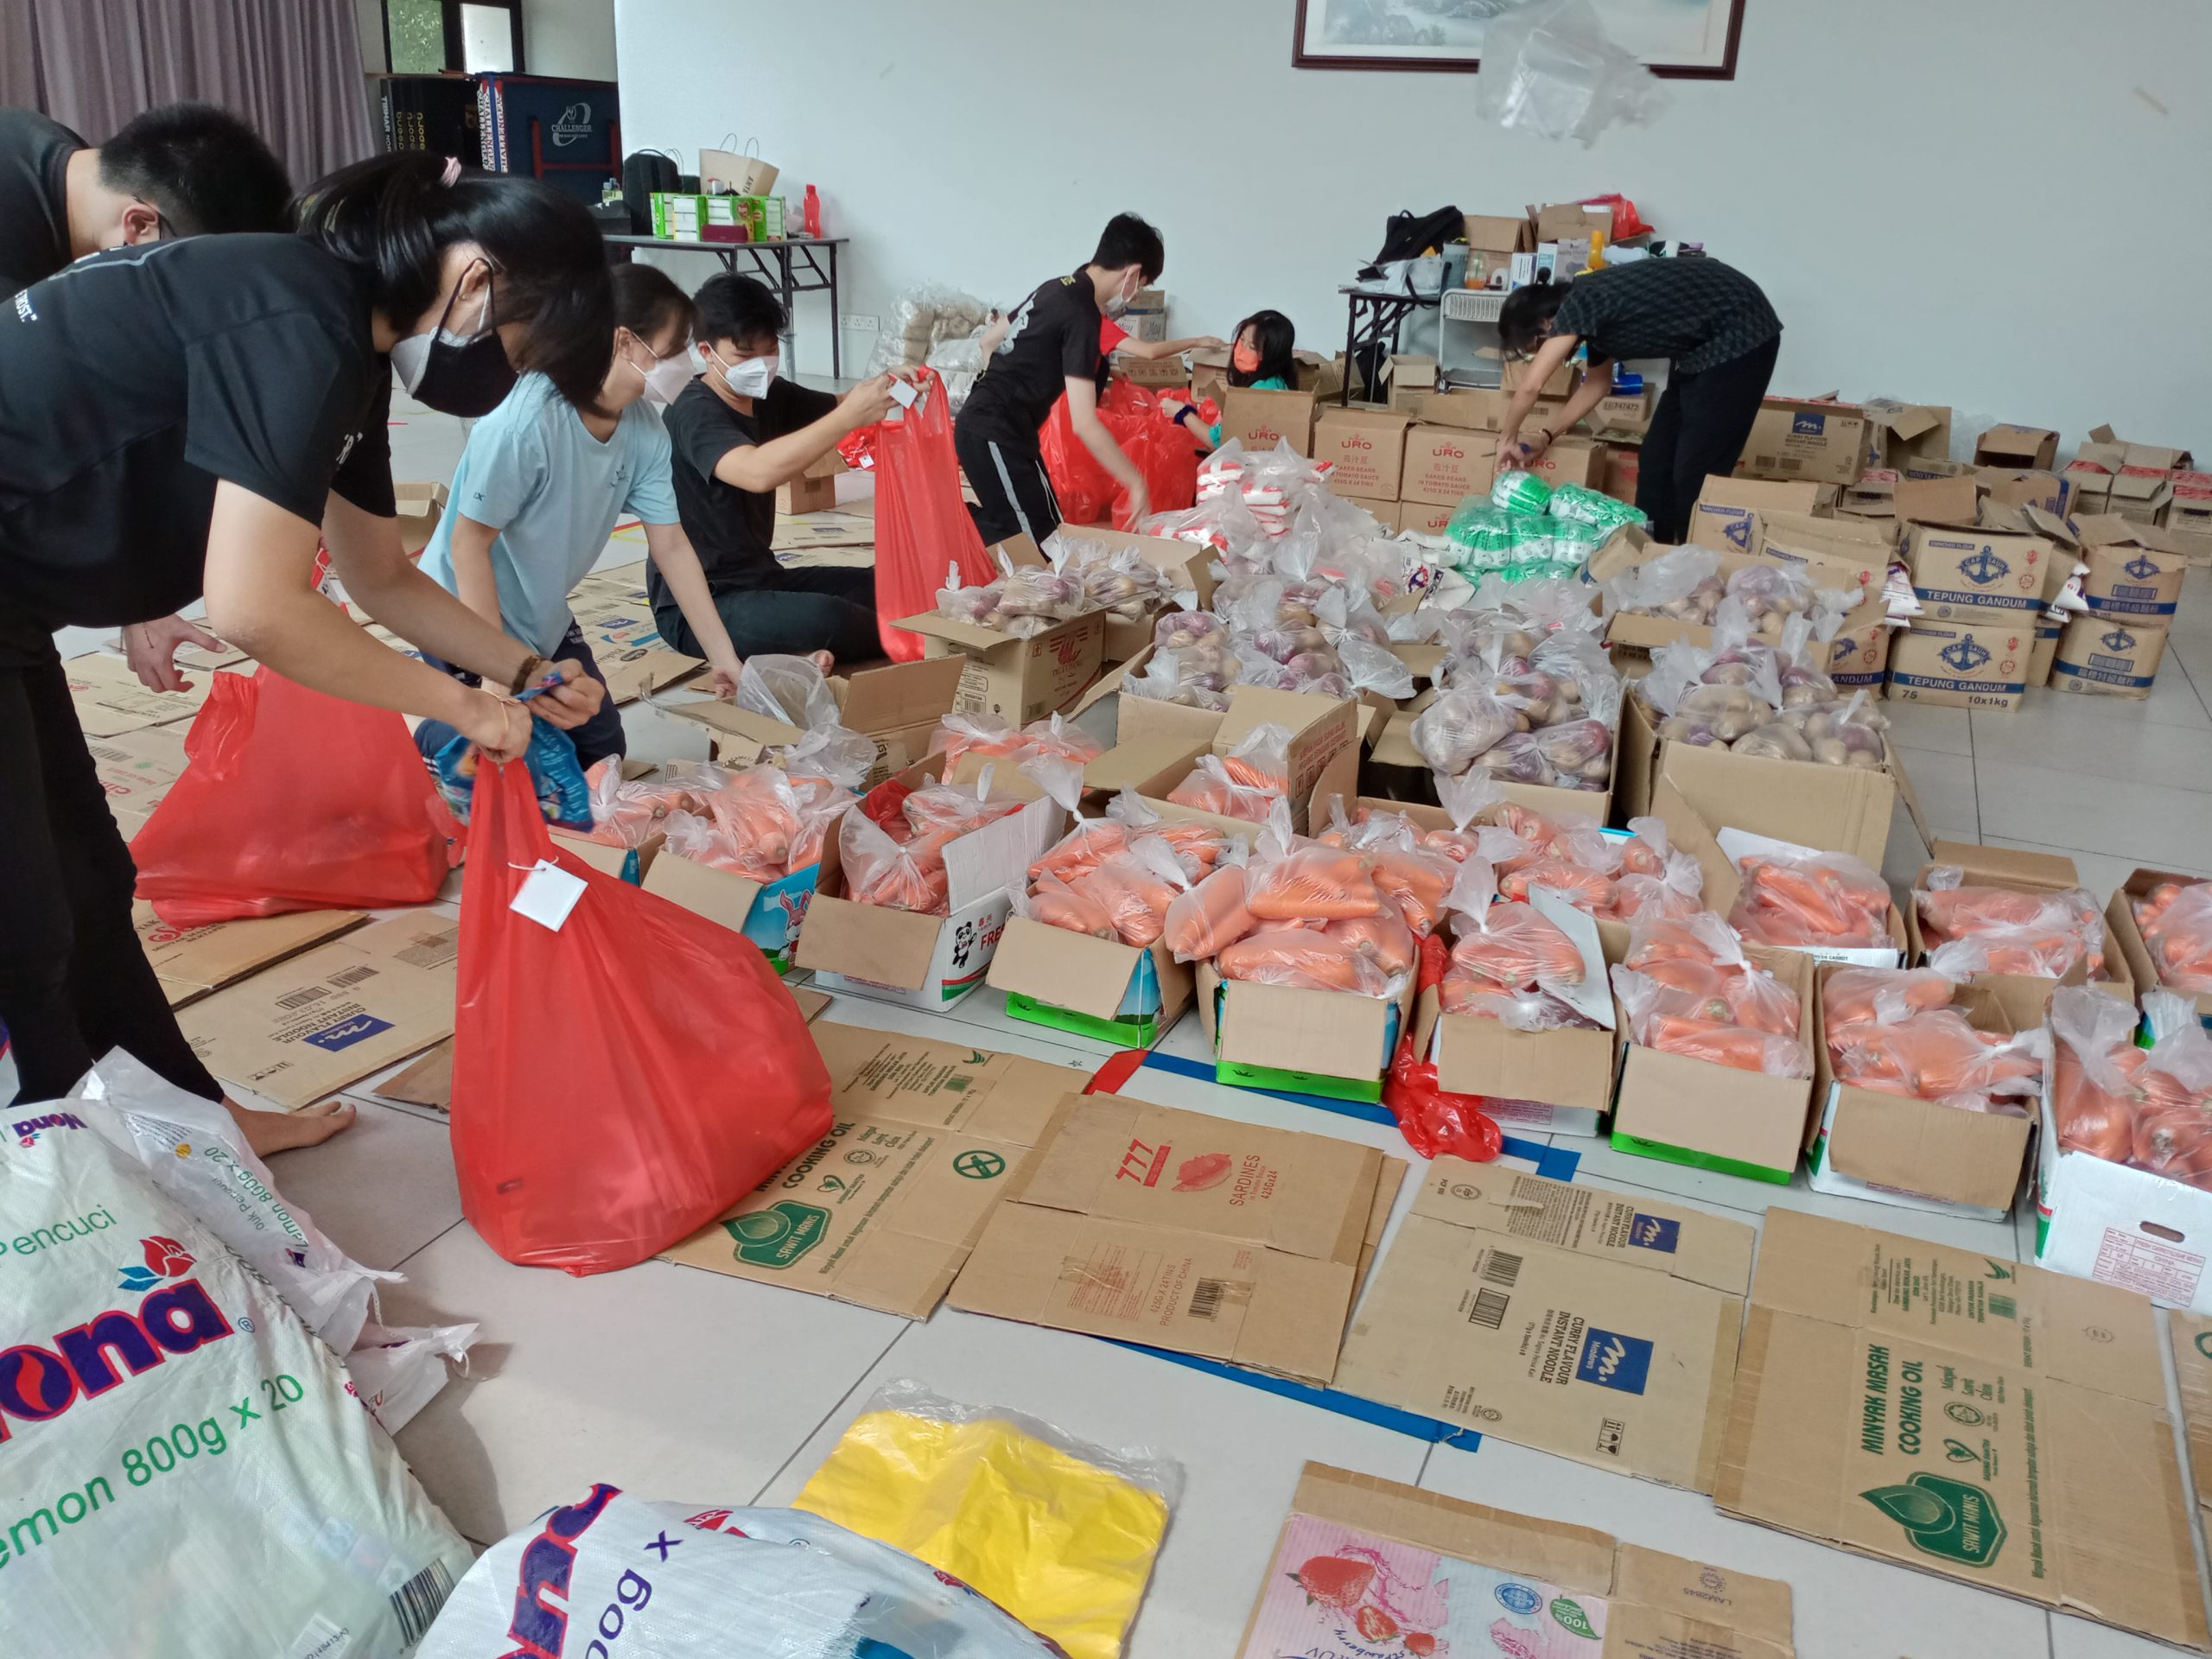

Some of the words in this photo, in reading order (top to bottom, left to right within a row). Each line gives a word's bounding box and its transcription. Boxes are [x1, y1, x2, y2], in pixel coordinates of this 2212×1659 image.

[551, 124, 593, 133] CHALLENGER
[1249, 428, 1280, 442] URO
[1341, 439, 1372, 450] URO
[1433, 448, 1465, 459] URO
[1427, 520, 1448, 529] UR
[1965, 556, 1981, 567] CAP
[1986, 556, 2006, 570] SAUH
[1926, 590, 1974, 604] TEPUNG
[1977, 595, 2028, 609] GANDUM
[1946, 644, 1962, 655] CAP
[1968, 645, 1987, 658] SAUH
[1833, 674, 1873, 684] ANDUM
[1907, 675, 1955, 690] TEPUNG
[1958, 679, 2007, 692] GANDUM
[1902, 690, 1918, 700] 75
[1967, 695, 2009, 707] 10x1kg
[204, 1147, 229, 1163] 20
[781, 1138, 838, 1189] COOKING
[830, 1122, 856, 1138] OIL
[1115, 1138, 1154, 1183] 777
[237, 1170, 274, 1203] 800g
[1229, 1154, 1261, 1207] SARDINES
[1260, 1169, 1278, 1200] 425Gx24
[775, 1236, 804, 1260] SAWIT
[798, 1213, 821, 1236] MANIS
[1159, 1289, 1179, 1327] PRODUCT
[1180, 1256, 1194, 1281] CHINA
[1550, 1310, 1572, 1348] INSTANT
[1568, 1316, 1586, 1345] CURRY
[0, 1277, 235, 1445] ona
[1540, 1345, 1560, 1384] NOODLE
[1555, 1343, 1578, 1386] FLAVOUR
[1865, 1343, 1890, 1395] MASAK
[1901, 1360, 1923, 1383] OIL
[1860, 1394, 1887, 1456] MINYAK
[1897, 1385, 1923, 1456] COOKING
[0, 1473, 115, 1571] emon
[120, 1417, 228, 1487] 800g
[229, 1396, 261, 1430] x
[260, 1374, 304, 1412] 20
[1962, 1493, 1980, 1522] MANIS
[643, 1529, 684, 1563] x
[1962, 1522, 1980, 1554] SAWIT
[1555, 1611, 1589, 1630] 100%
